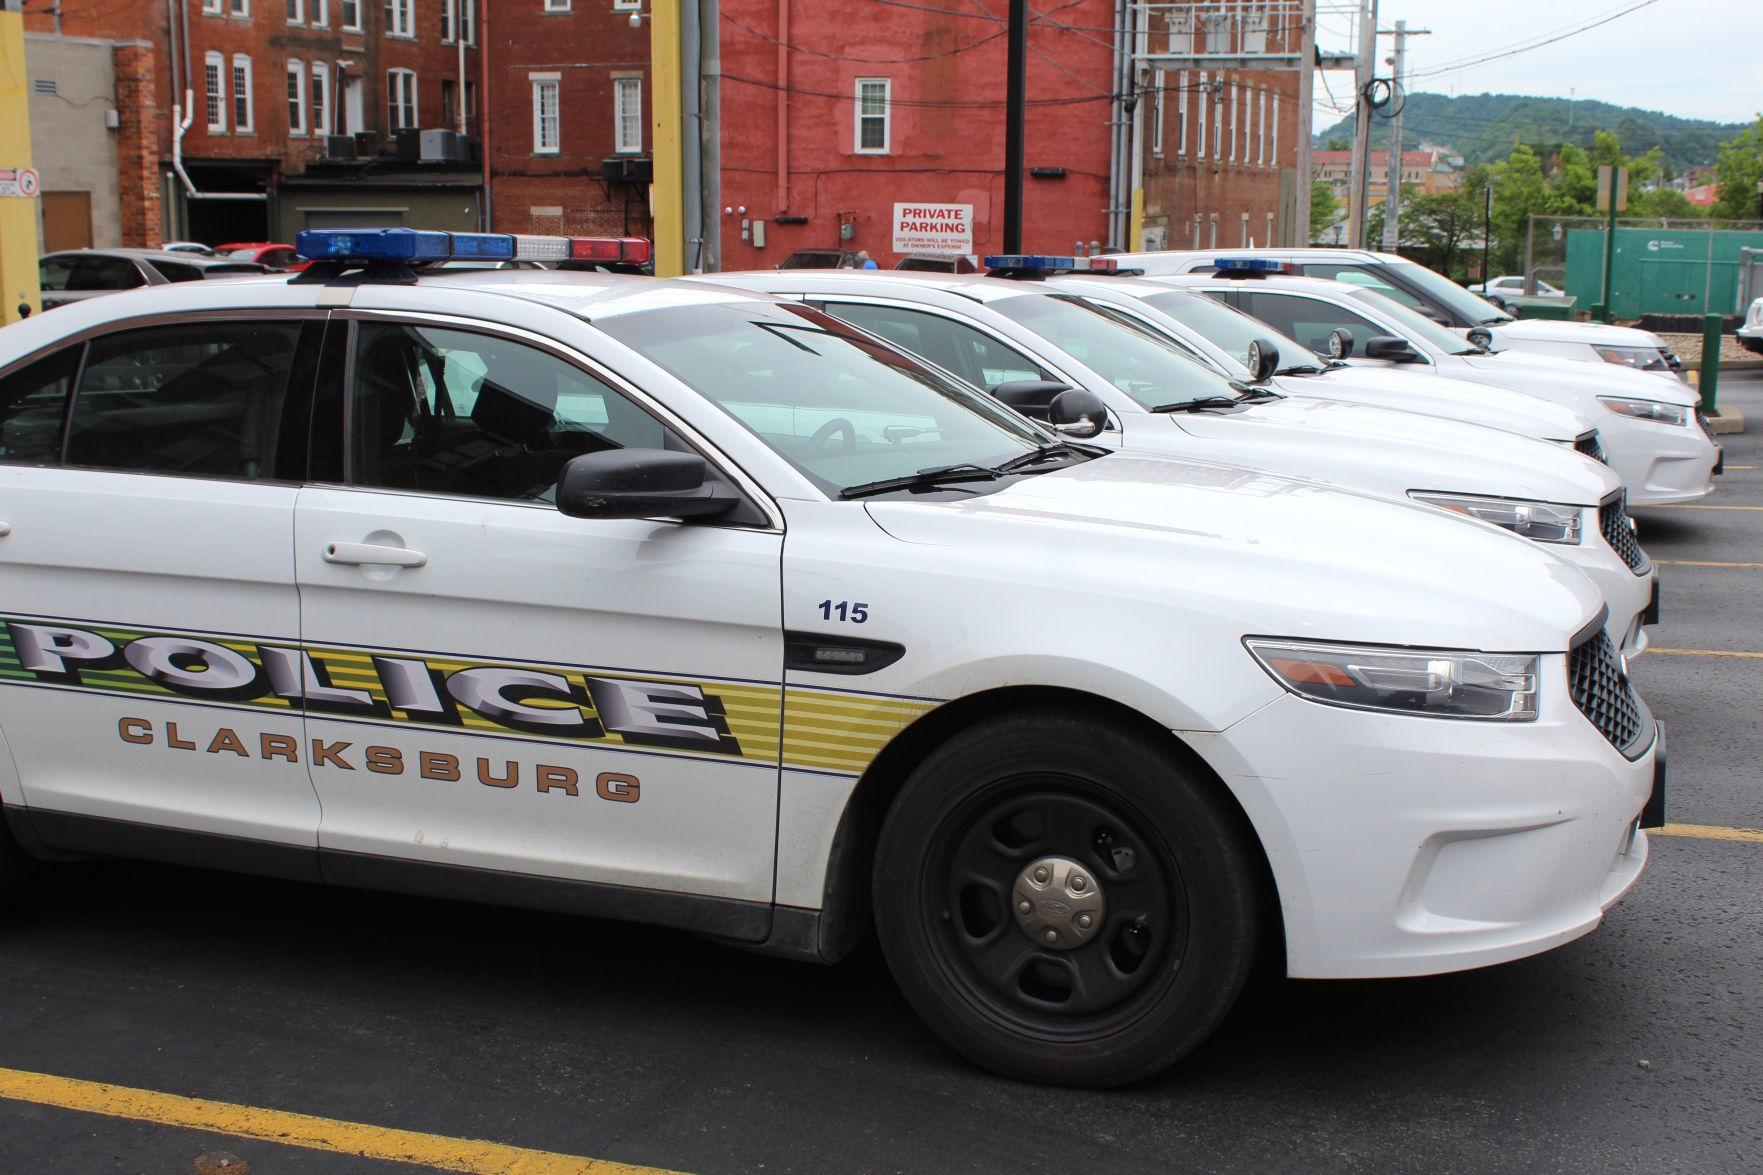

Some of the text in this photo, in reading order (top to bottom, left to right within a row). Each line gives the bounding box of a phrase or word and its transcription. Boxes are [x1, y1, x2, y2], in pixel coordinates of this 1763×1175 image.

[903, 208, 963, 220] PRIVATE
[900, 221, 965, 233] PARKING
[818, 599, 869, 624] 115
[5, 621, 744, 756] POLICE
[118, 716, 641, 803] CLARKSBURG
